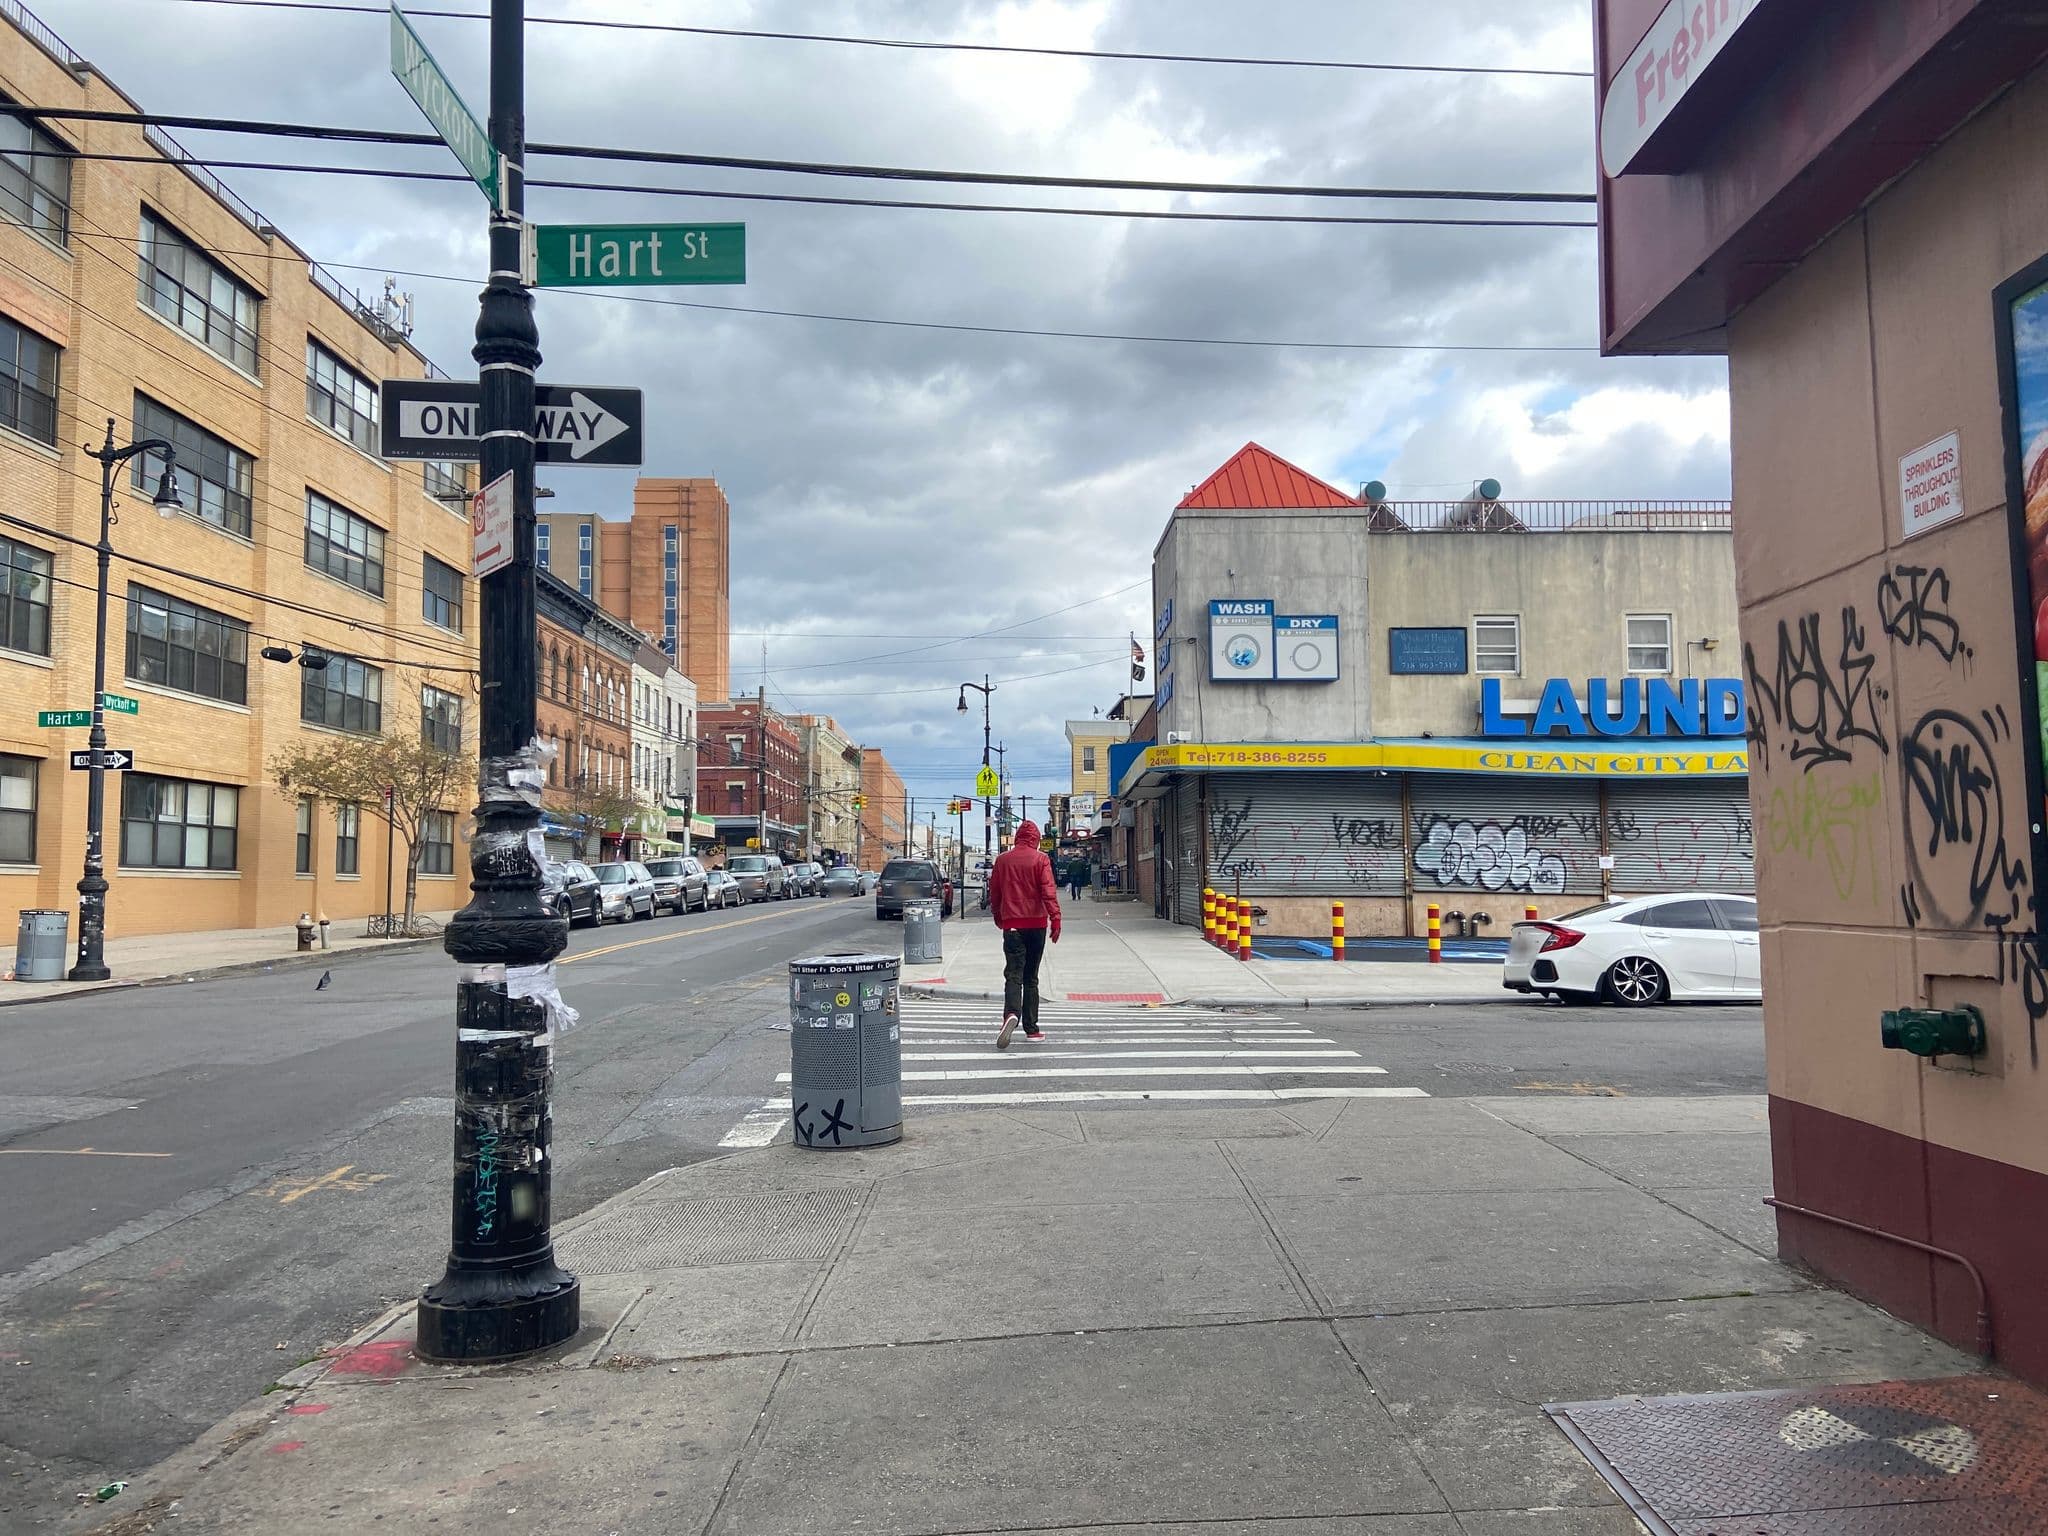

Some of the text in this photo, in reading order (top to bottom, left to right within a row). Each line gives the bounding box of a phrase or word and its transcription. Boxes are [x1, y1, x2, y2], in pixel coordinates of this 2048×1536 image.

[403, 27, 475, 164] Wyckoff
[568, 230, 709, 278] Hart St
[420, 405, 604, 441] ON WAY
[1905, 447, 1954, 482] SPRINKLERS
[1904, 467, 1958, 502] THROUGHOUT
[1914, 491, 1950, 518] BUILDING
[1218, 604, 1266, 614] WASH
[1290, 619, 1322, 628] DRY
[106, 696, 129, 710] Wyckoff
[1481, 678, 1745, 736] LAUND
[47, 712, 83, 725] Hart St
[104, 756, 122, 764] WAY
[1151, 758, 1160, 766] 24
[1479, 752, 1749, 772] CLEAN CITY LA
[802, 966, 818, 974] litter
[855, 964, 874, 972] litter
